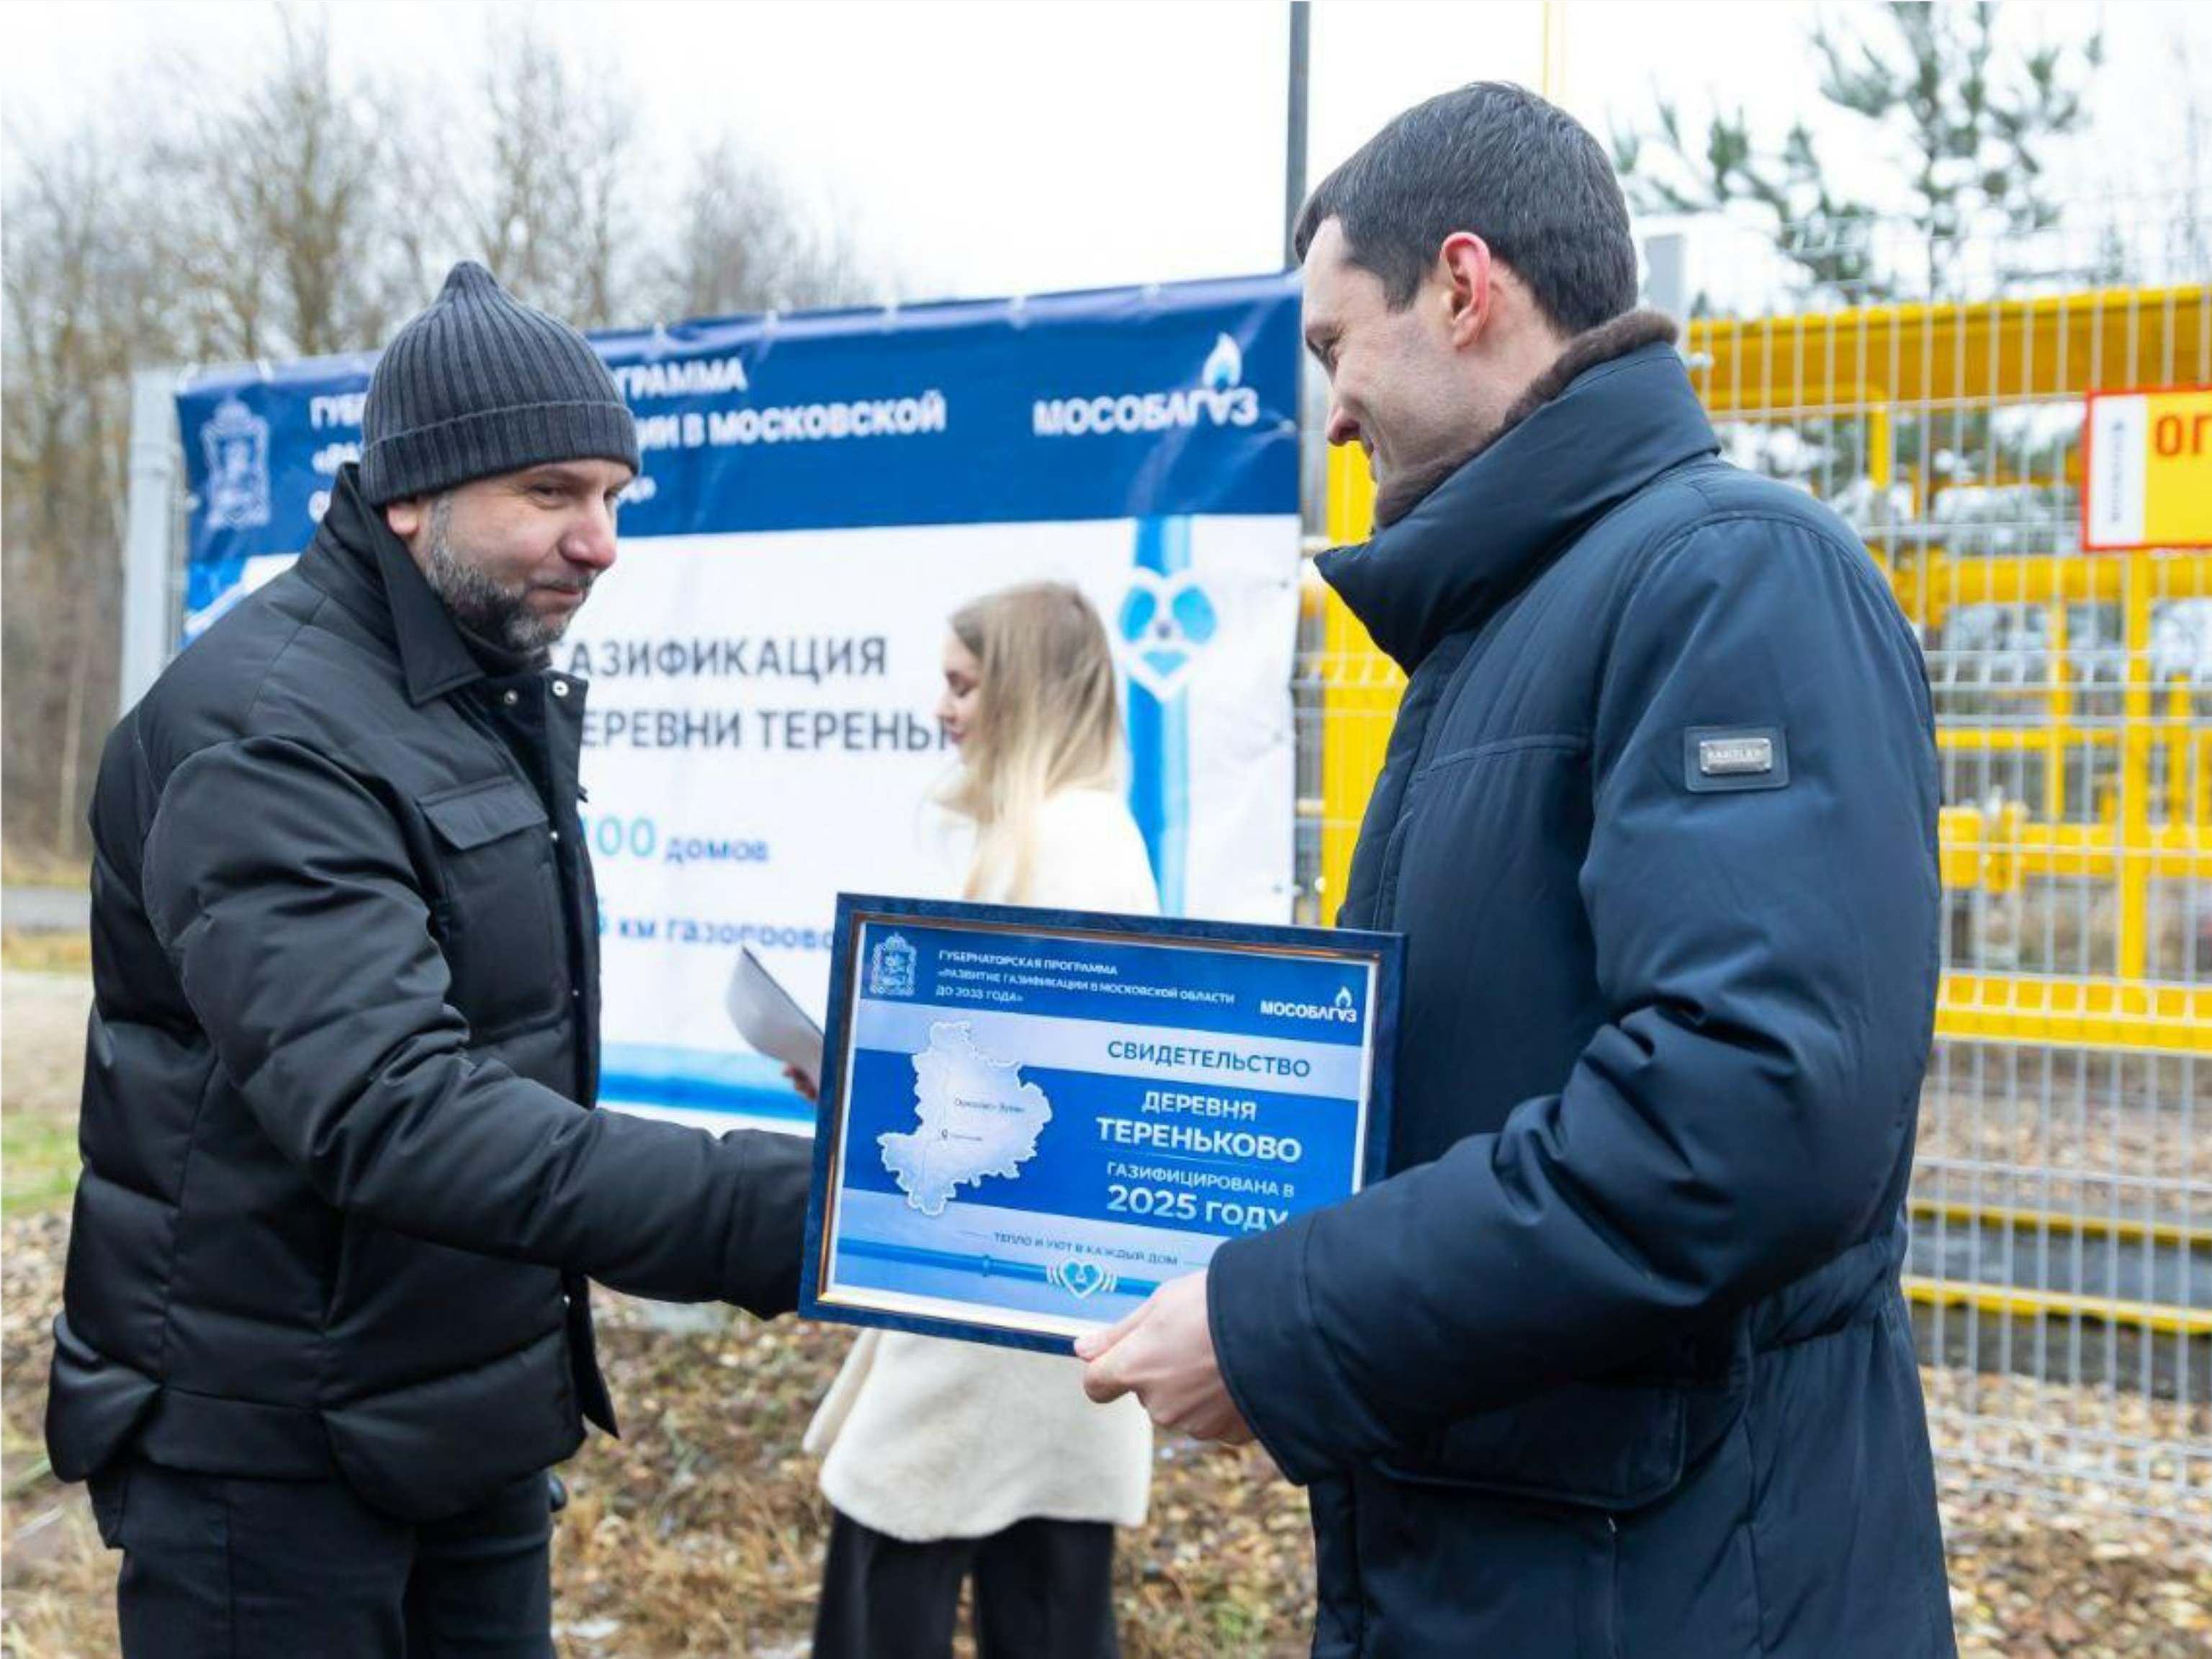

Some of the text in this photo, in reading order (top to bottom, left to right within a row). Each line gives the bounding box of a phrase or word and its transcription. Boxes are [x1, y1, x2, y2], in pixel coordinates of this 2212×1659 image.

[614, 357, 749, 400] ГРАММА
[683, 413, 704, 448] В
[709, 390, 946, 447] МОСКОВСКОЙ
[581, 709, 949, 751] ЕРЕВНИ ТЕРЕНЬ
[667, 918, 832, 949] газопрово
[1043, 959, 1118, 975] ПРОГРАММА
[1099, 981, 1179, 999] МОСКОВСКОЙ
[1179, 989, 1235, 1004] ОБЛАСТИ
[1107, 1040, 1310, 1078] СВИДЕТЕЛЬСТВО
[1141, 1090, 1256, 1122] ДЕРЕВНЯ
[1095, 1116, 1303, 1164] ТЕРЕНЬКОВО
[1107, 1161, 1295, 1198] ГАЗИФИЦИРОВАНА В
[1106, 1184, 1198, 1220] 2025
[1148, 1254, 1179, 1266] ДОМ
